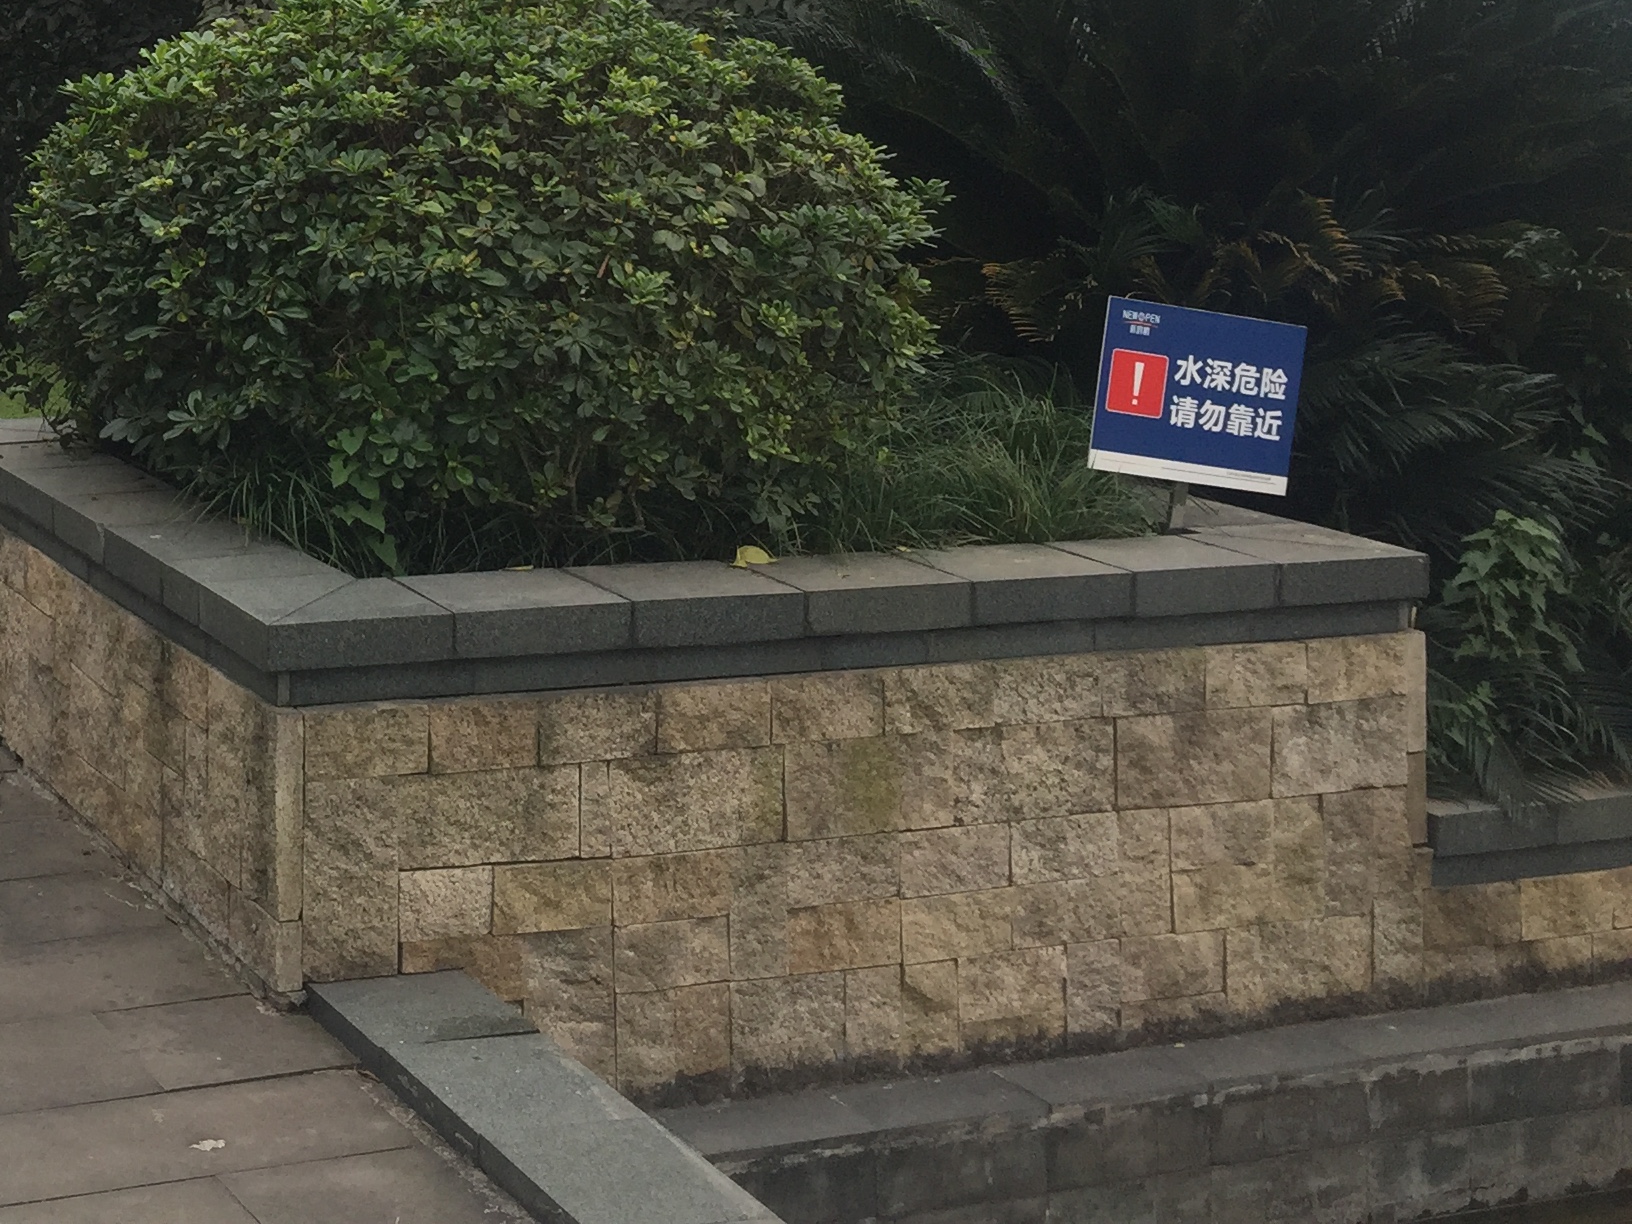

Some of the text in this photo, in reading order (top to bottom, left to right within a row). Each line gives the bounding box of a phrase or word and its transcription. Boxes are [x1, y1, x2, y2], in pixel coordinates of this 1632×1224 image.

[1174, 355, 1288, 400] 水深危险
[1169, 395, 1282, 441] 请勿靠近
